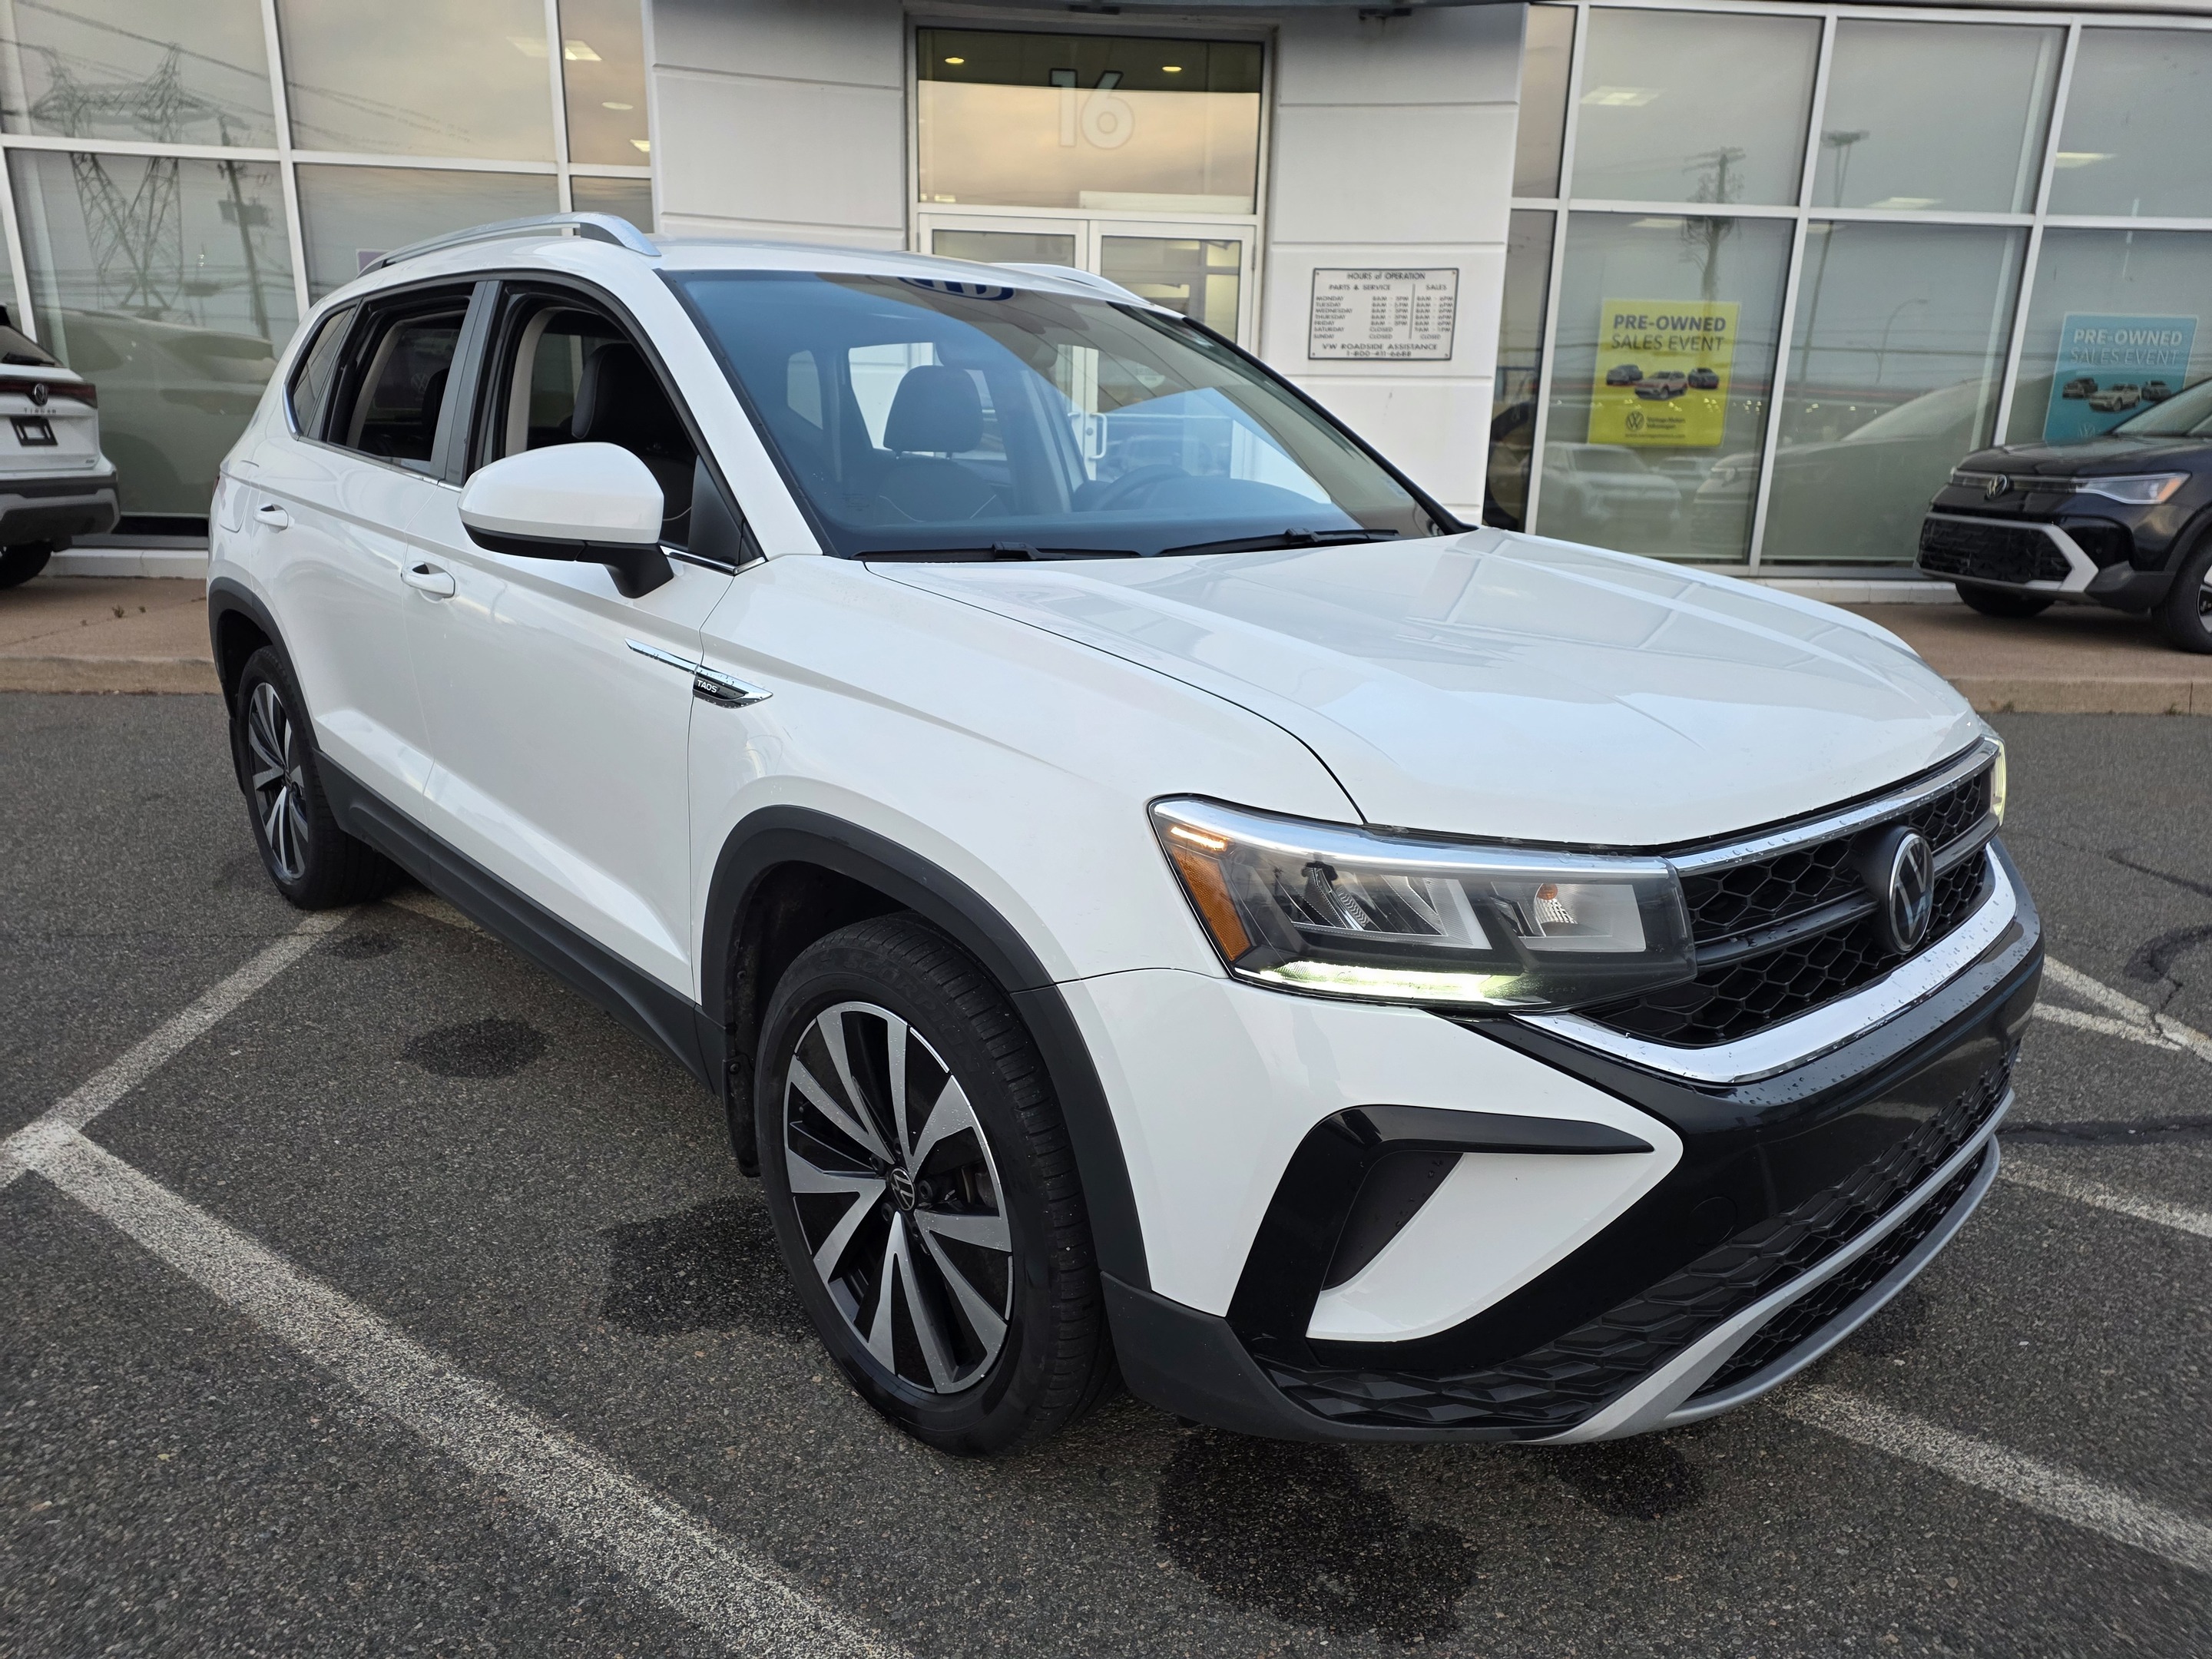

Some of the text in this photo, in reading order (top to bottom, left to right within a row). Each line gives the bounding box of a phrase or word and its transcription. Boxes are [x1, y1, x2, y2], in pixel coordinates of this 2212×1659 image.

[1048, 68, 1135, 150] 16
[1385, 271, 1426, 280] OPERATION
[1614, 313, 1727, 332] PRE-OWNED
[1611, 333, 1725, 352] SALES EVENT
[2073, 328, 2183, 345] PRE-OWNED
[2070, 346, 2181, 366] SALES EVENT
[696, 679, 718, 694] TAOS
